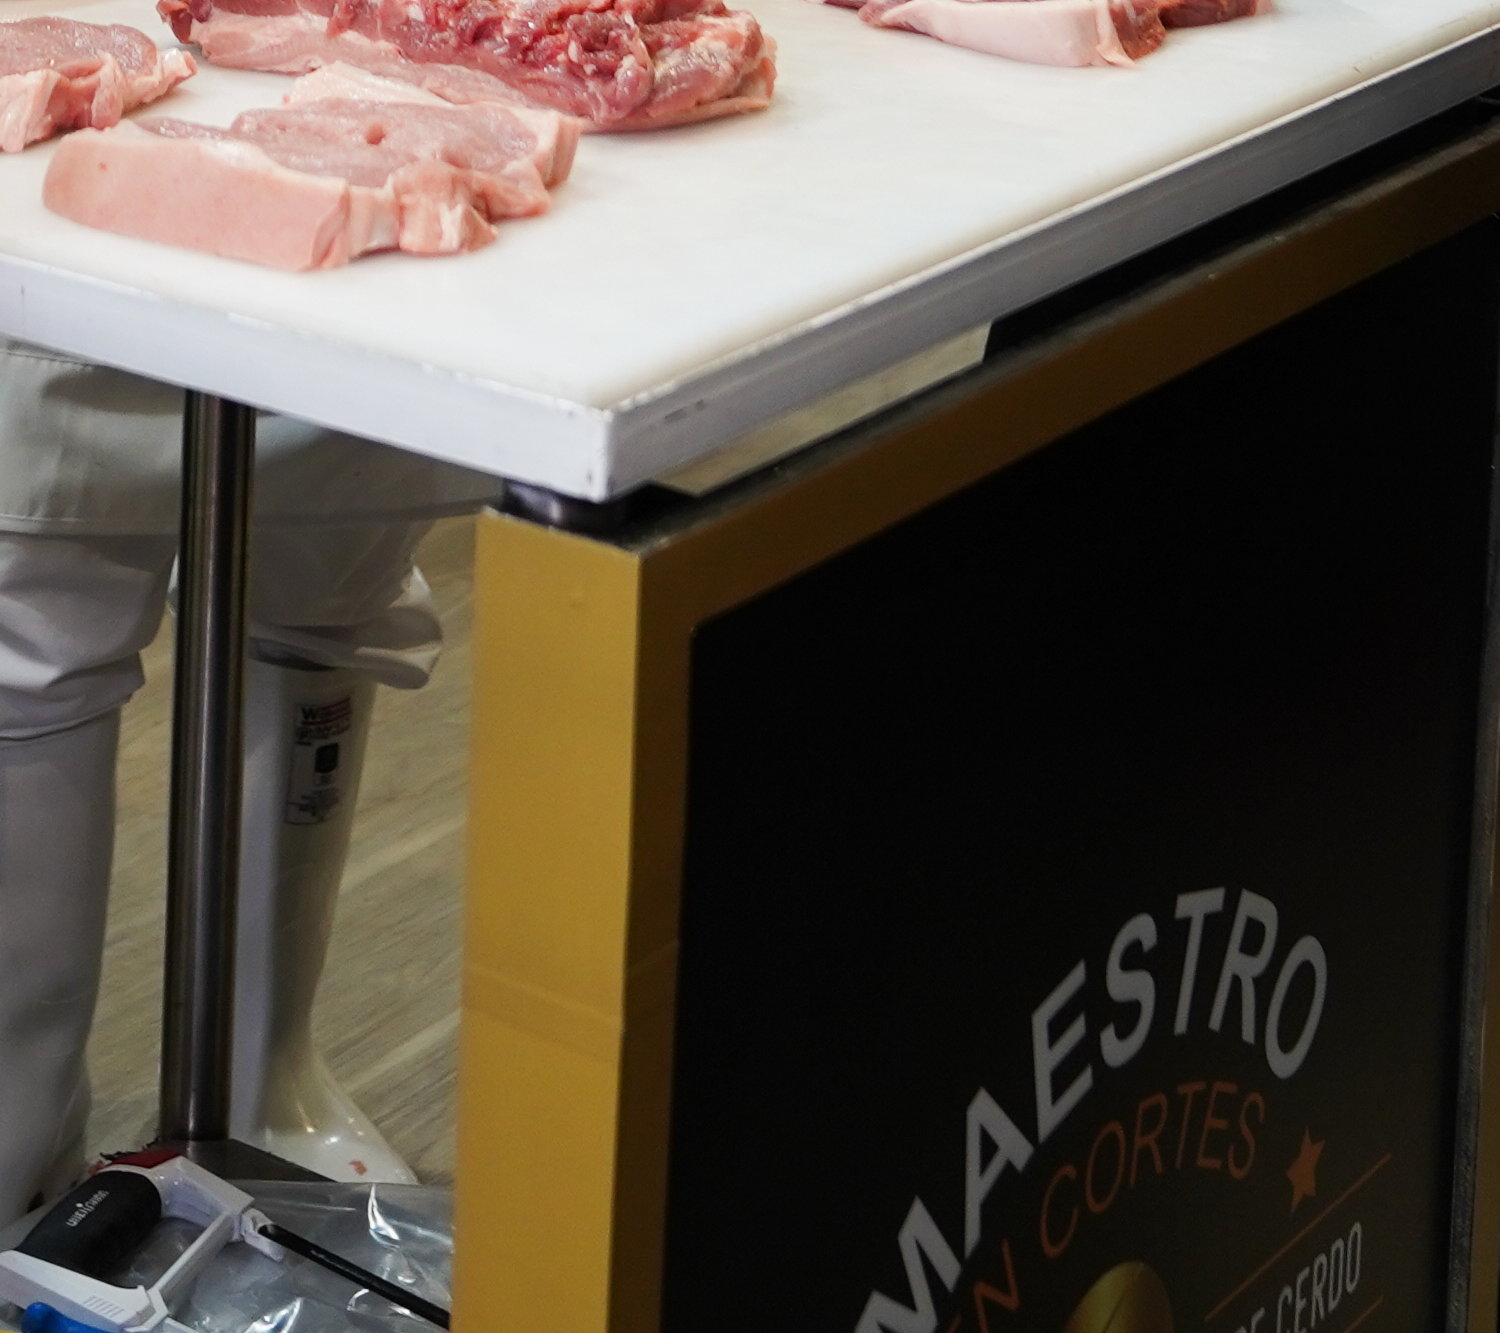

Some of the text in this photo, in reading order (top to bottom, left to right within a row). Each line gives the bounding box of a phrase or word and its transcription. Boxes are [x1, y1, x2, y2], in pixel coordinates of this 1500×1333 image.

[853, 886, 1328, 1333] MAESTRO
[1039, 1080, 1266, 1261] CORTES
[1275, 1221, 1363, 1333] CERDO
